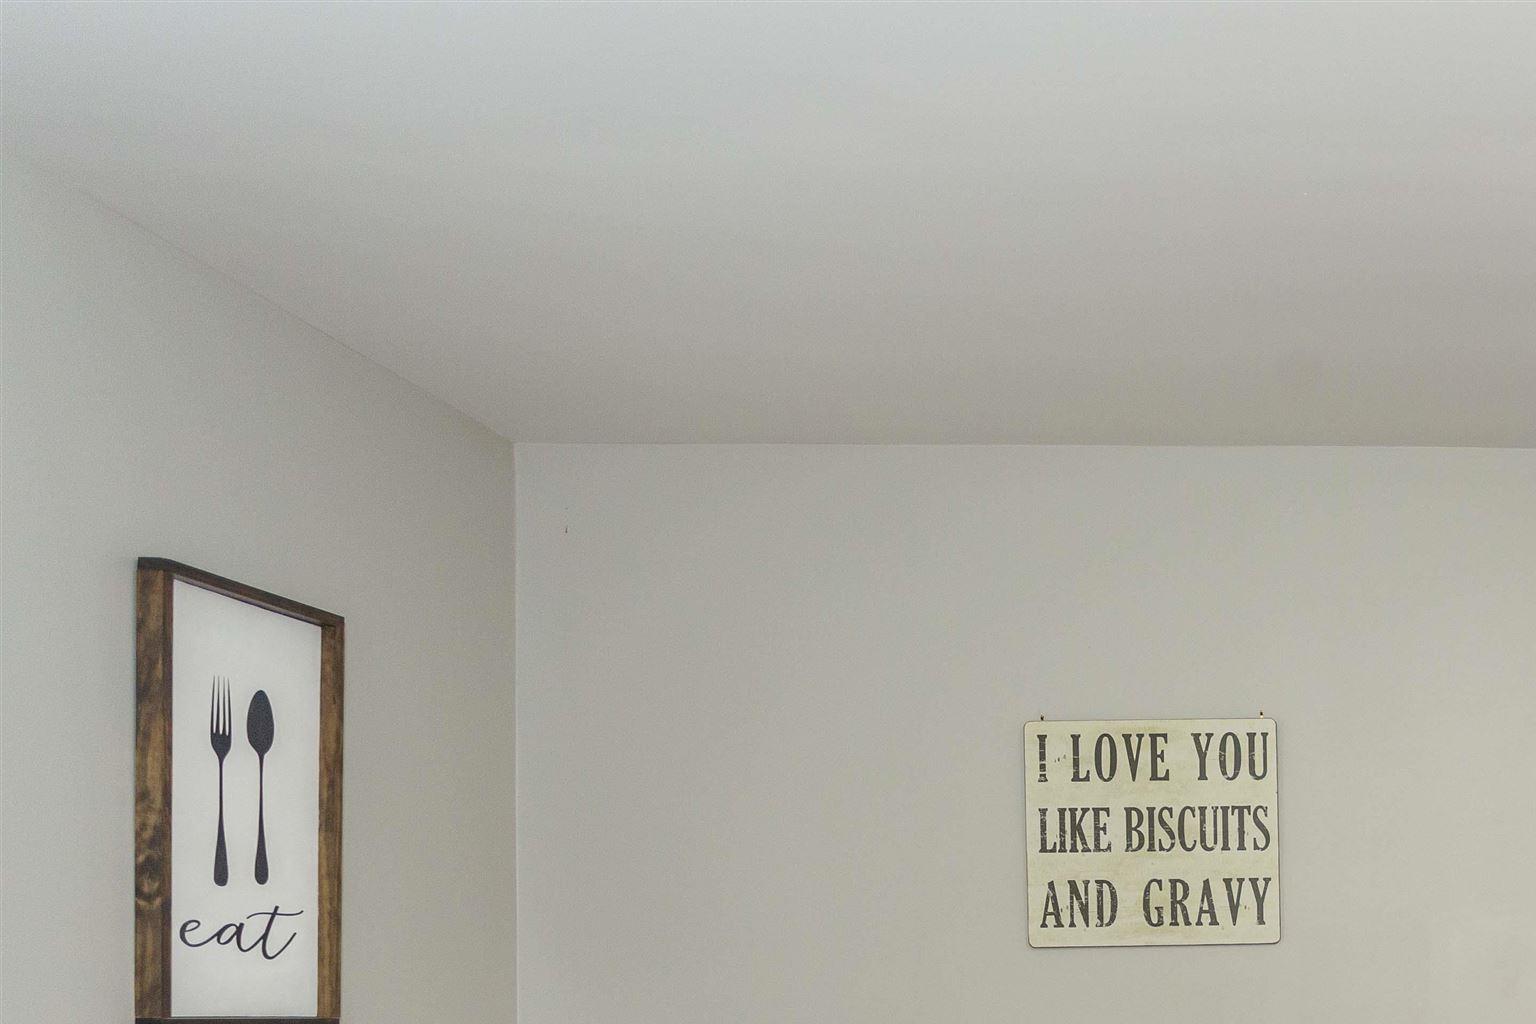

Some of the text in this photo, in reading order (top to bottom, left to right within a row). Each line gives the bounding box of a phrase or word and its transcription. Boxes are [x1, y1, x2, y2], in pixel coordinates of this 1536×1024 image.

[1037, 732, 1269, 782] I LOVE YOU
[1038, 805, 1271, 853] LIKE BISCUITS
[1040, 877, 1272, 928] AND GRAVY
[179, 905, 303, 960] eat
